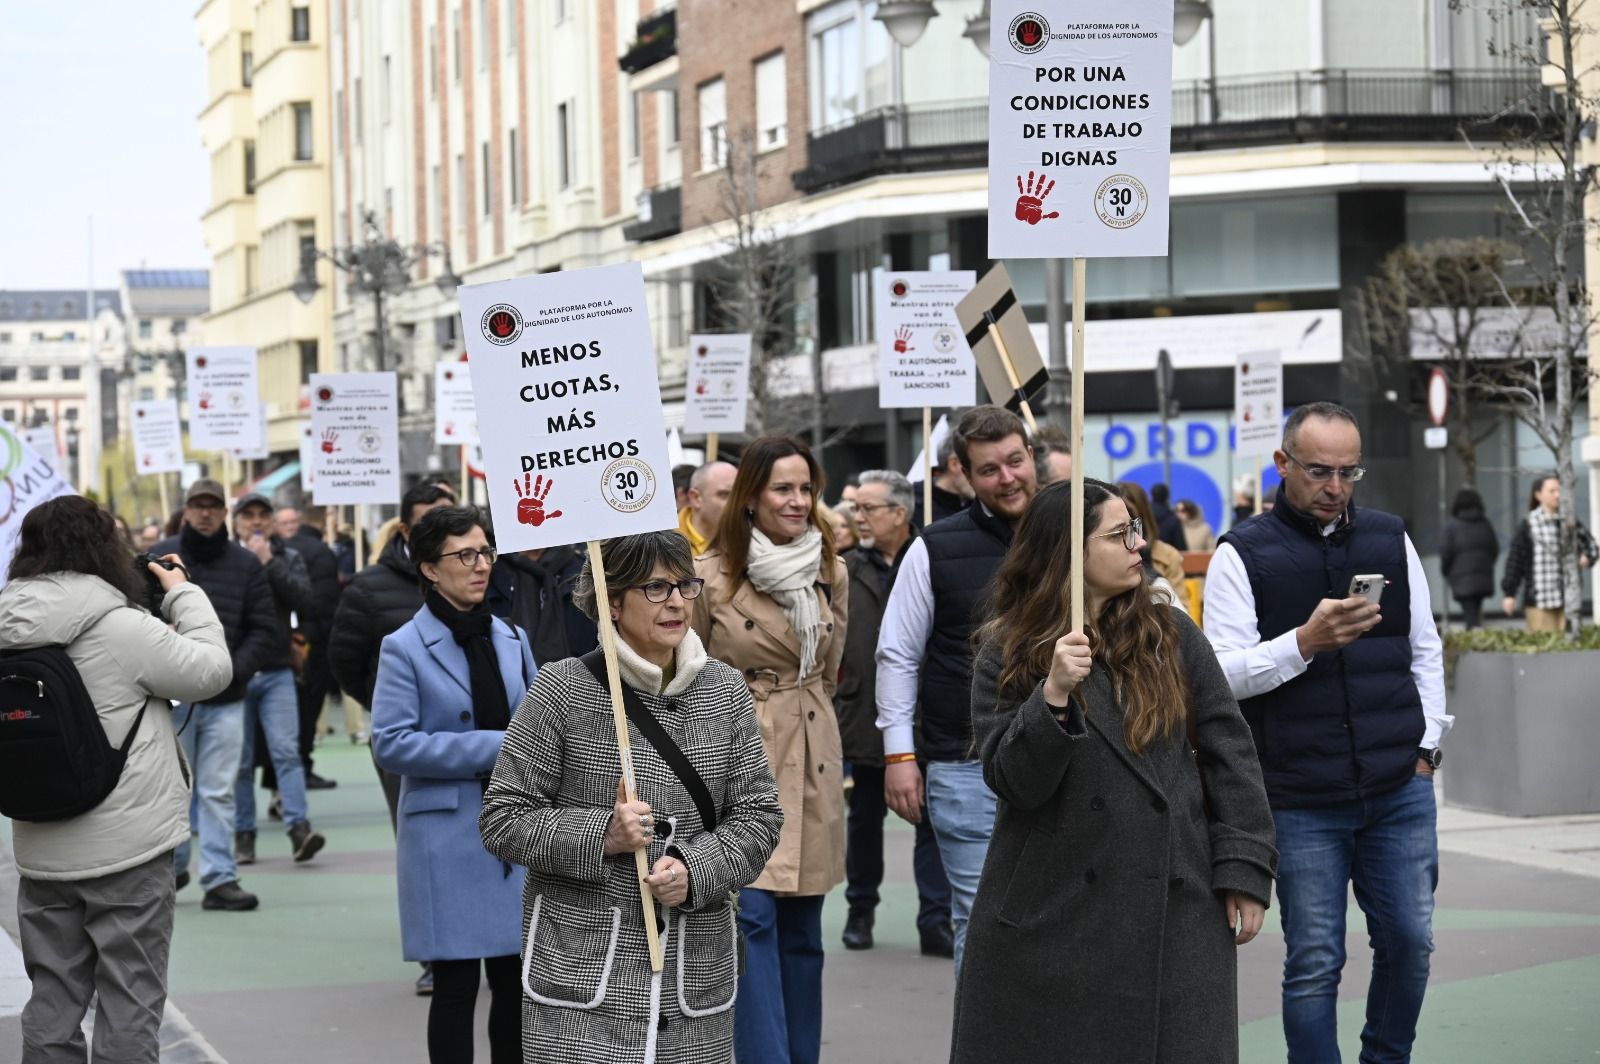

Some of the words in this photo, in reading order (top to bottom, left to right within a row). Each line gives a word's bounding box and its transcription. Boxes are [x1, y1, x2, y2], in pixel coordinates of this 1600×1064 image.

[1036, 67, 1076, 82] POR
[1083, 66, 1126, 82] UNA
[1010, 94, 1150, 110] CONDICIONES
[1023, 124, 1046, 138] DE
[1053, 122, 1142, 138] TRABAJO
[1041, 150, 1118, 166] DIGNAS
[1110, 188, 1132, 206] 30
[1116, 206, 1124, 216] N
[524, 317, 560, 328] DIGNIDAD
[586, 306, 632, 318] AUTONOMOS
[540, 304, 586, 316] PLATAFORMA
[521, 340, 602, 368] MENOS
[520, 374, 620, 402] CUOTAS,
[547, 408, 596, 434] MÁS
[520, 439, 639, 472] DERECHOS
[615, 470, 638, 490] 30
[624, 489, 634, 500] N
